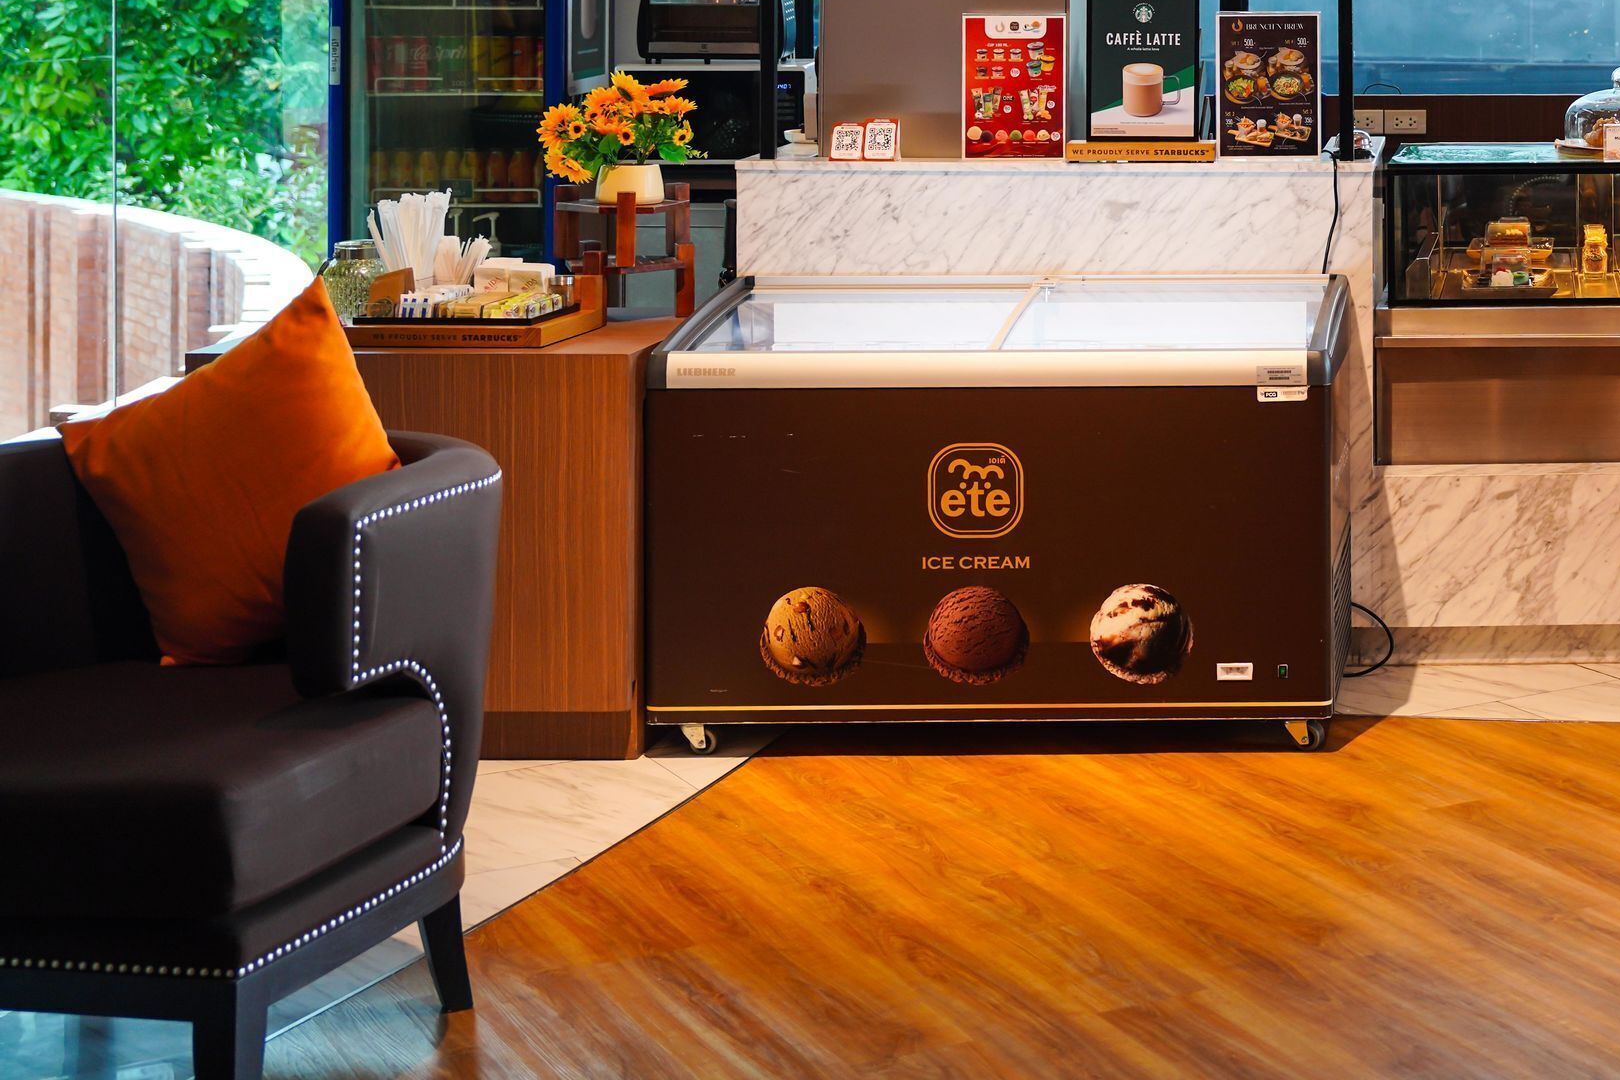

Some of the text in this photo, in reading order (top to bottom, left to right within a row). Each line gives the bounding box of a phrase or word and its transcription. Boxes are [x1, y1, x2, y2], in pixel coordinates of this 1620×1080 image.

[1106, 31, 1181, 46] CAFFÈ LATTE
[677, 368, 736, 376] LIEBHERR
[922, 557, 1030, 570] ICE CREAM
